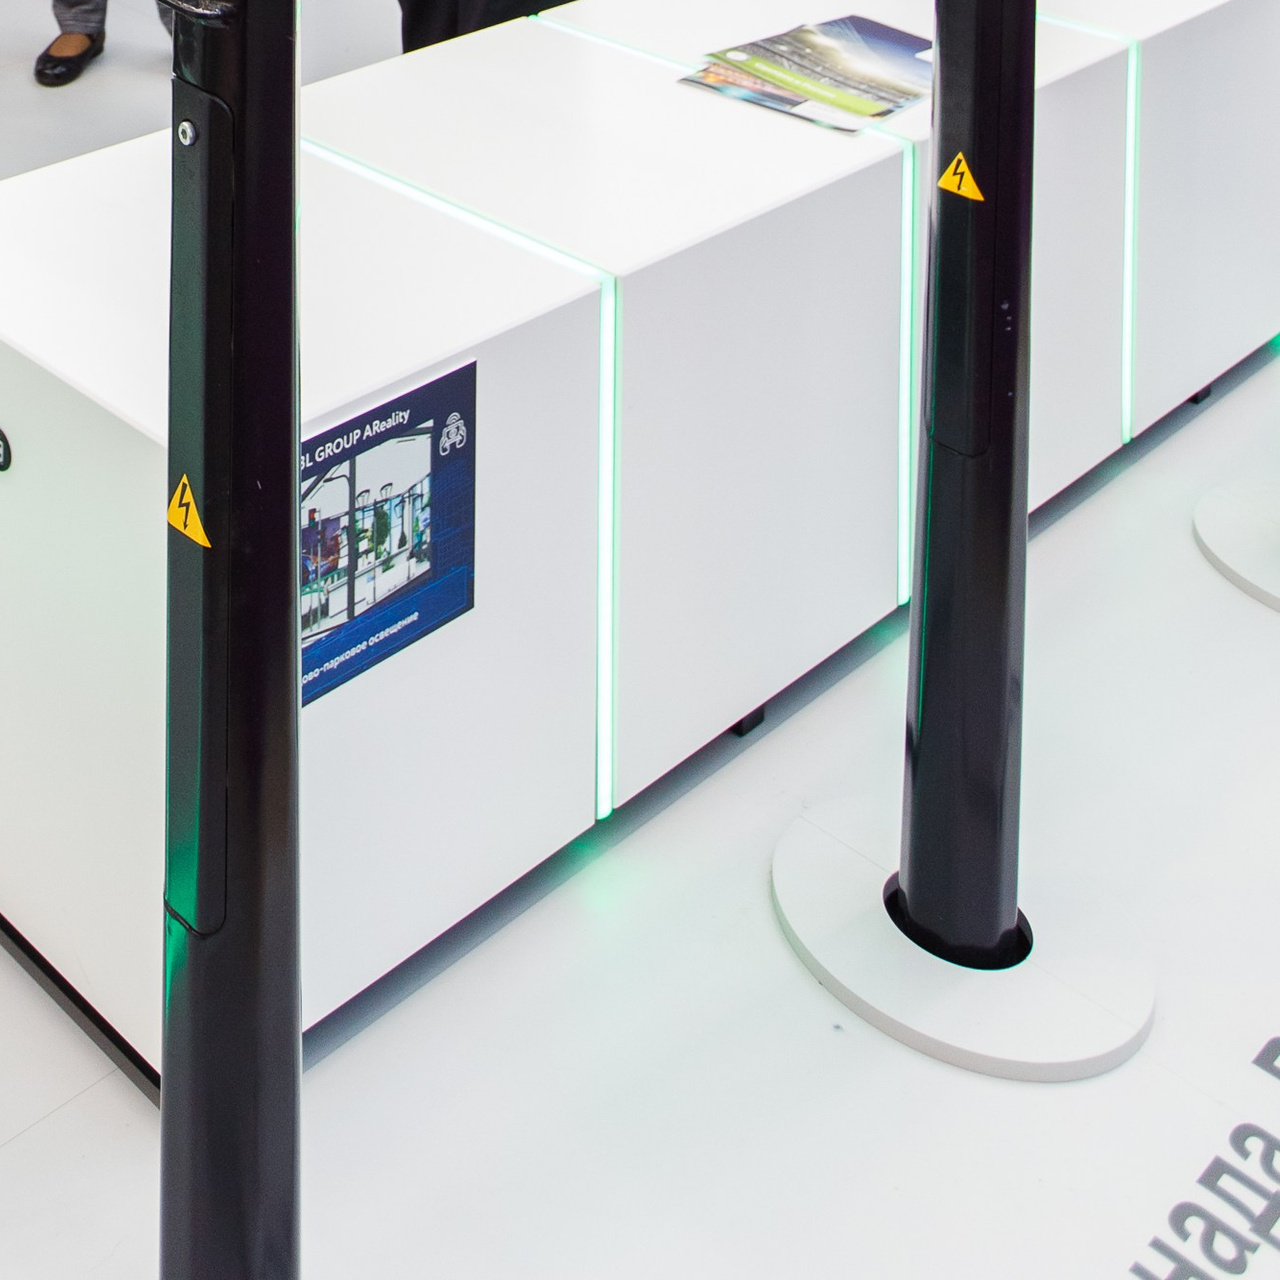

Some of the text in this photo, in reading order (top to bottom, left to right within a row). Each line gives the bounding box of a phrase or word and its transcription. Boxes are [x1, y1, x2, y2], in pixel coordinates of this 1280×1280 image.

[315, 428, 361, 462] GROUP
[363, 408, 411, 441] AReality
[301, 611, 419, 686] ово-парковое освещение
